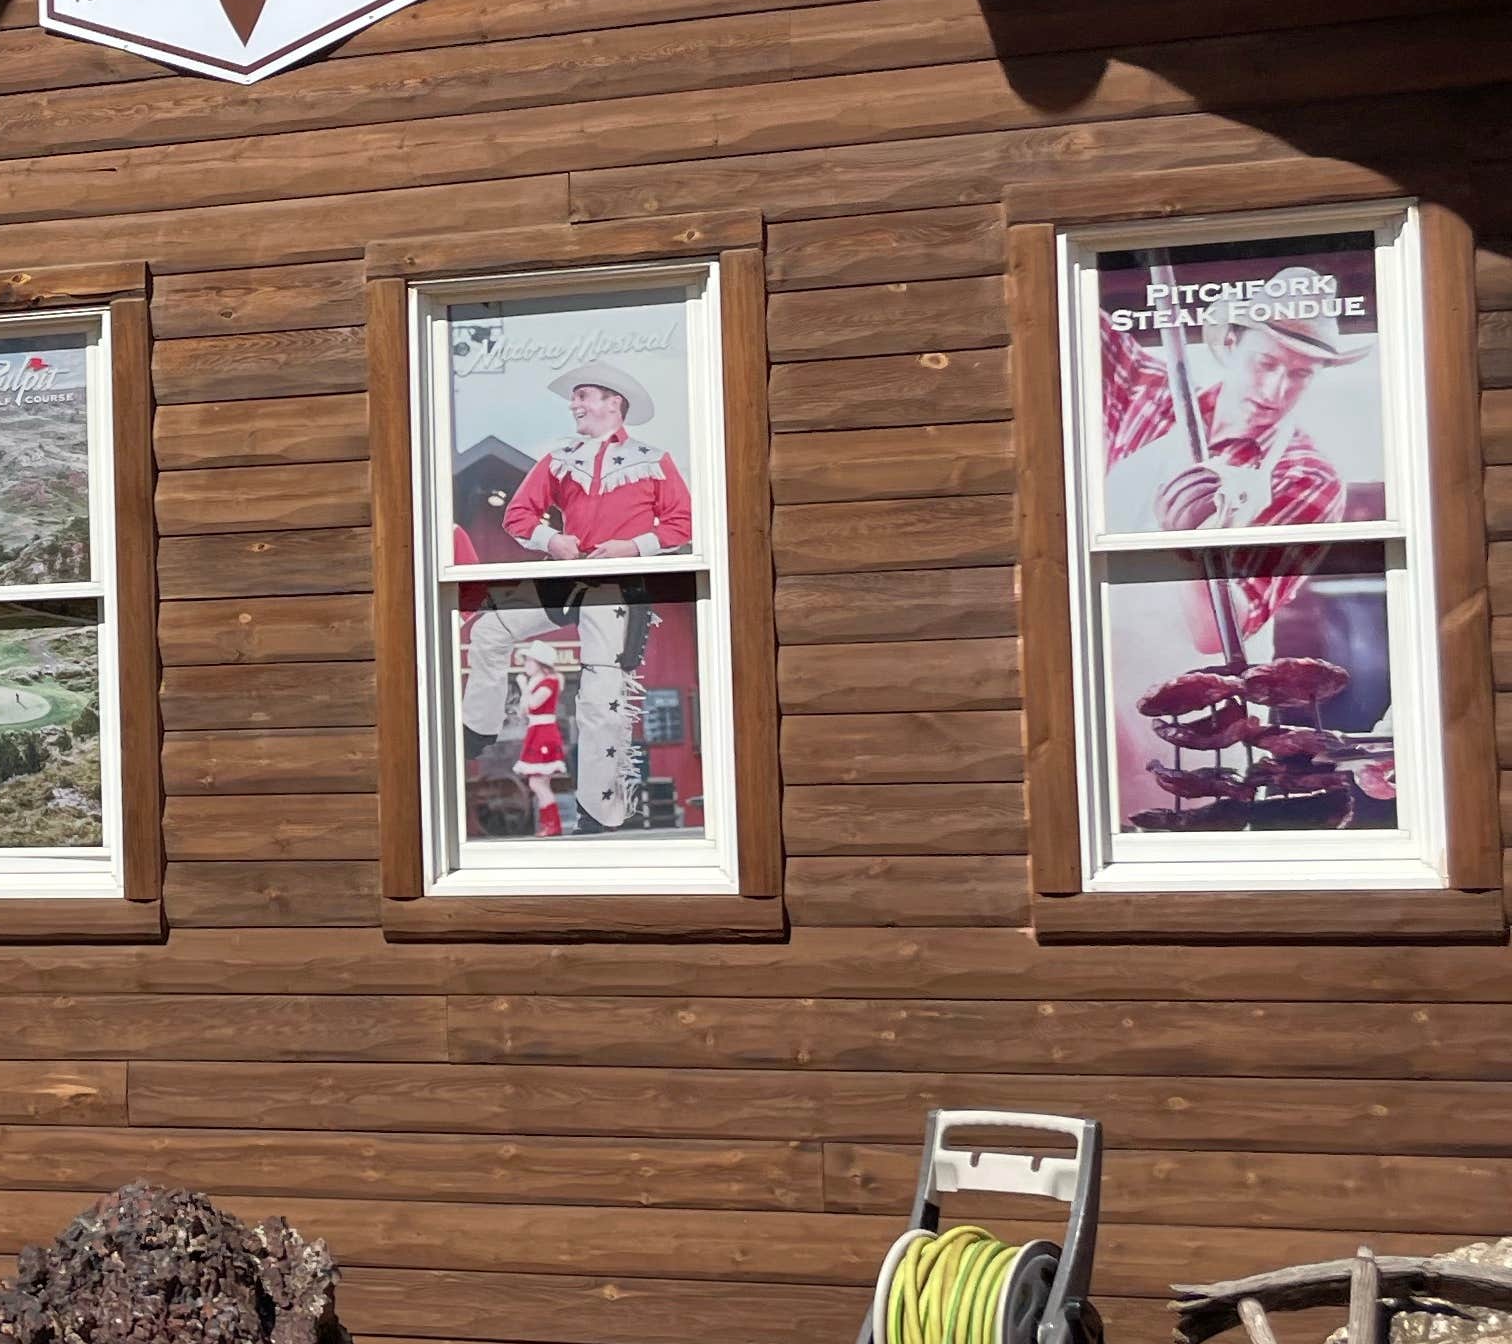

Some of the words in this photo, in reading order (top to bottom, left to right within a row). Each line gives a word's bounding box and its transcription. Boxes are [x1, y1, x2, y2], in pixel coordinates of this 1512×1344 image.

[1146, 274, 1337, 307] PITCHFORK
[1111, 307, 1218, 332] STEAK
[1229, 296, 1366, 324] FONDUE
[454, 338, 564, 377] Medora
[551, 322, 678, 370] Musical
[25, 392, 75, 405] COURSE
